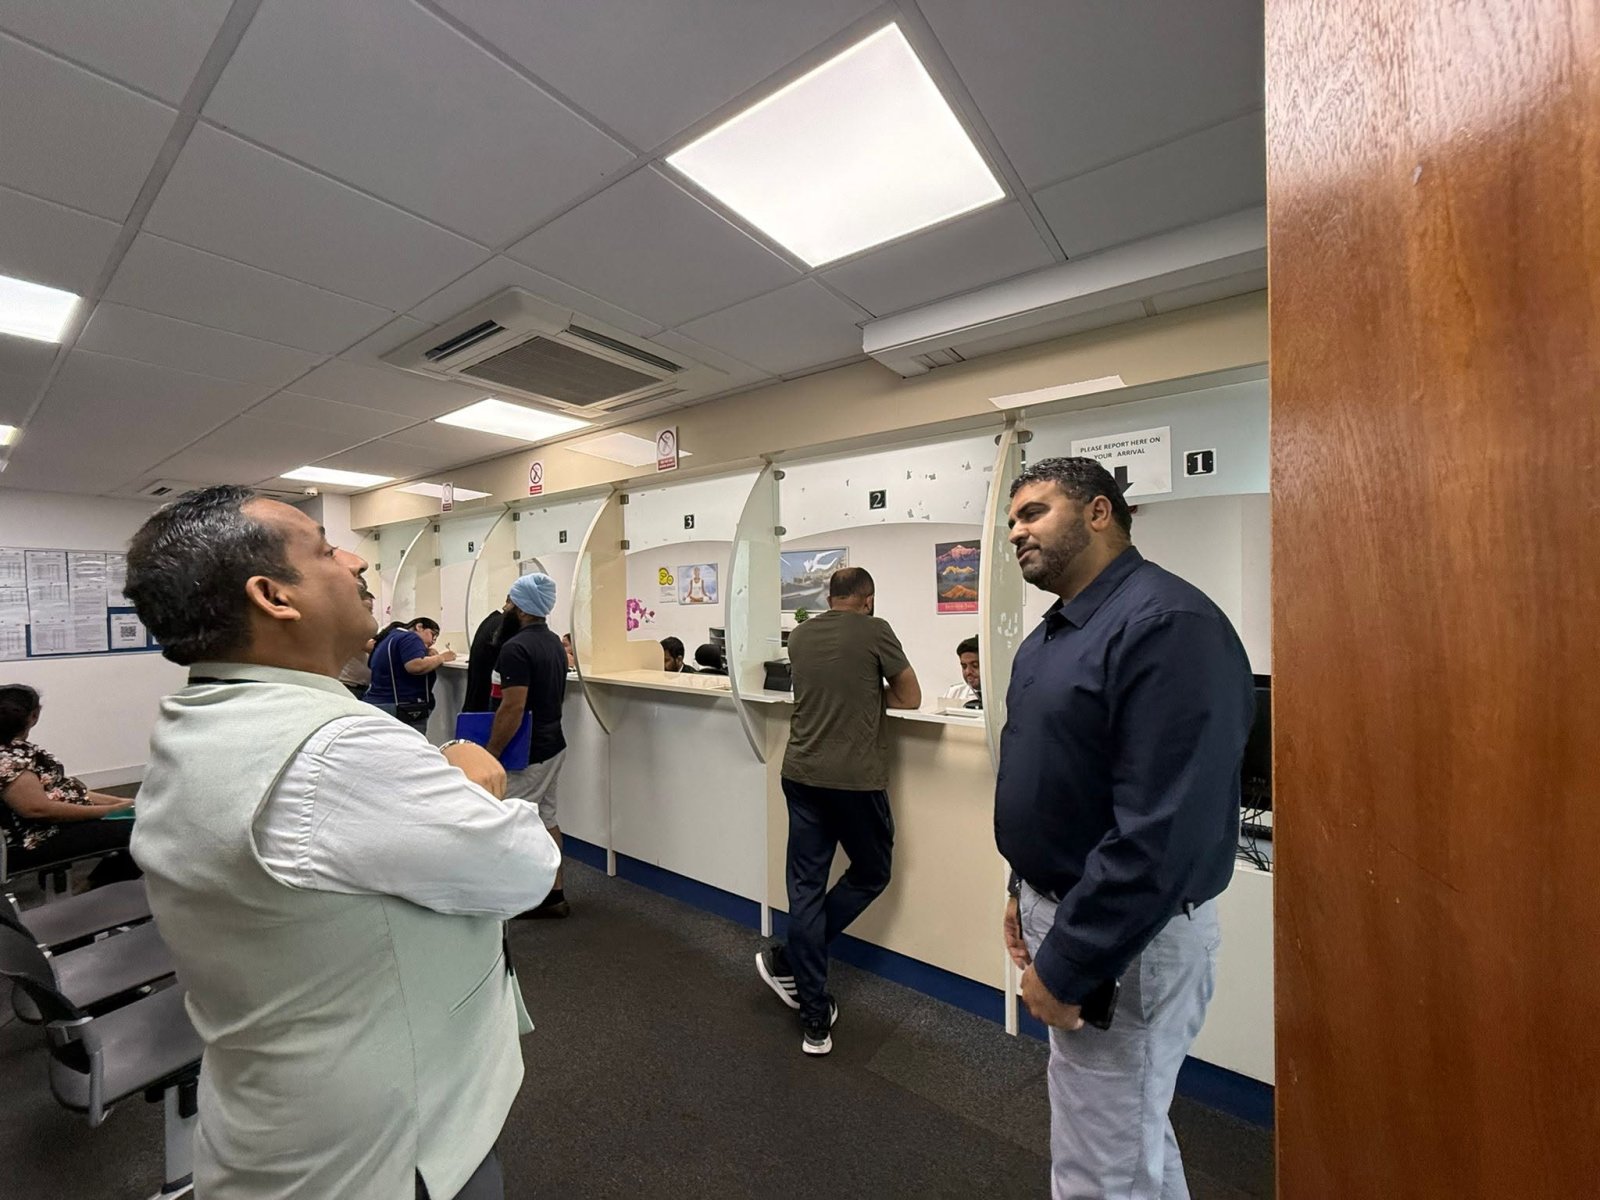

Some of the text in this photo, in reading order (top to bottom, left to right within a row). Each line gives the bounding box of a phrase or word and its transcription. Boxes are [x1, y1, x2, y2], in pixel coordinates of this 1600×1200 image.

[1080, 445, 1102, 453] PLEASE
[1104, 441, 1129, 450] REPORT
[1117, 448, 1145, 457] ARRIVAL
[1193, 453, 1206, 473] 1
[872, 492, 883, 508] 2
[685, 515, 694, 529] 3
